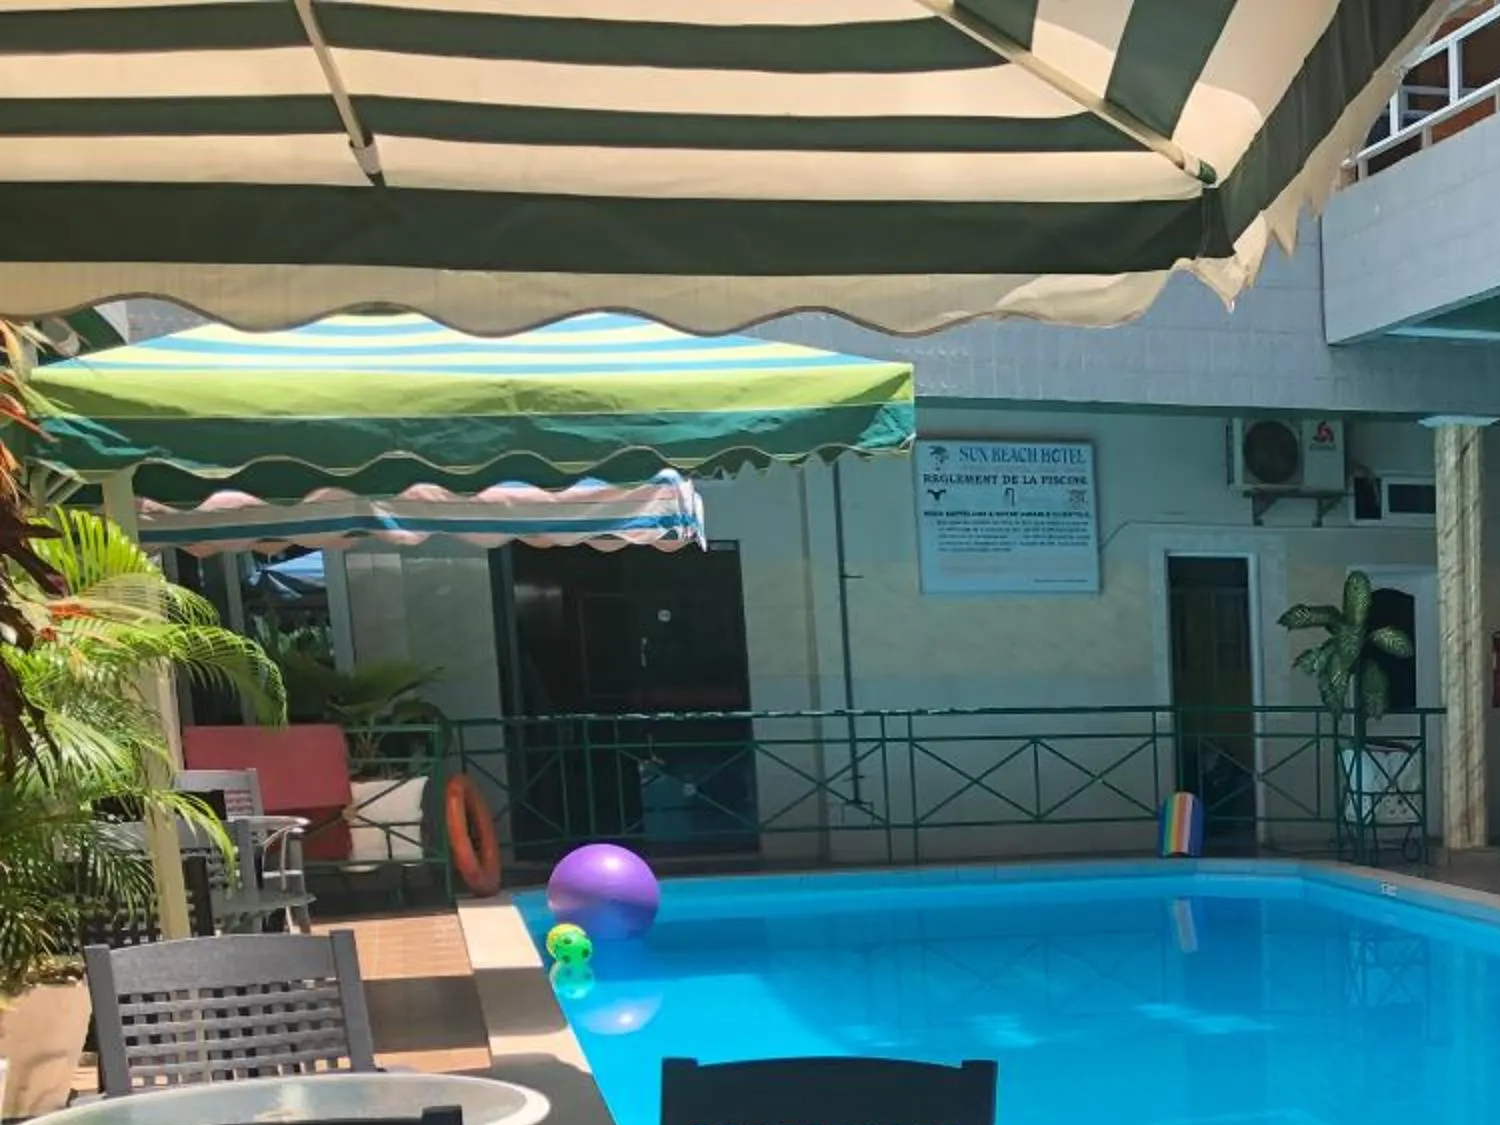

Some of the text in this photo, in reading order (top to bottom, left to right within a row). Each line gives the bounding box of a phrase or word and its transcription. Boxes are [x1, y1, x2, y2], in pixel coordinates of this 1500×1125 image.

[959, 447, 1087, 465] SUN BEACH HOTEL
[1002, 475, 1019, 485] DE
[1023, 475, 1037, 485] LA
[1041, 475, 1088, 486] PISCINE
